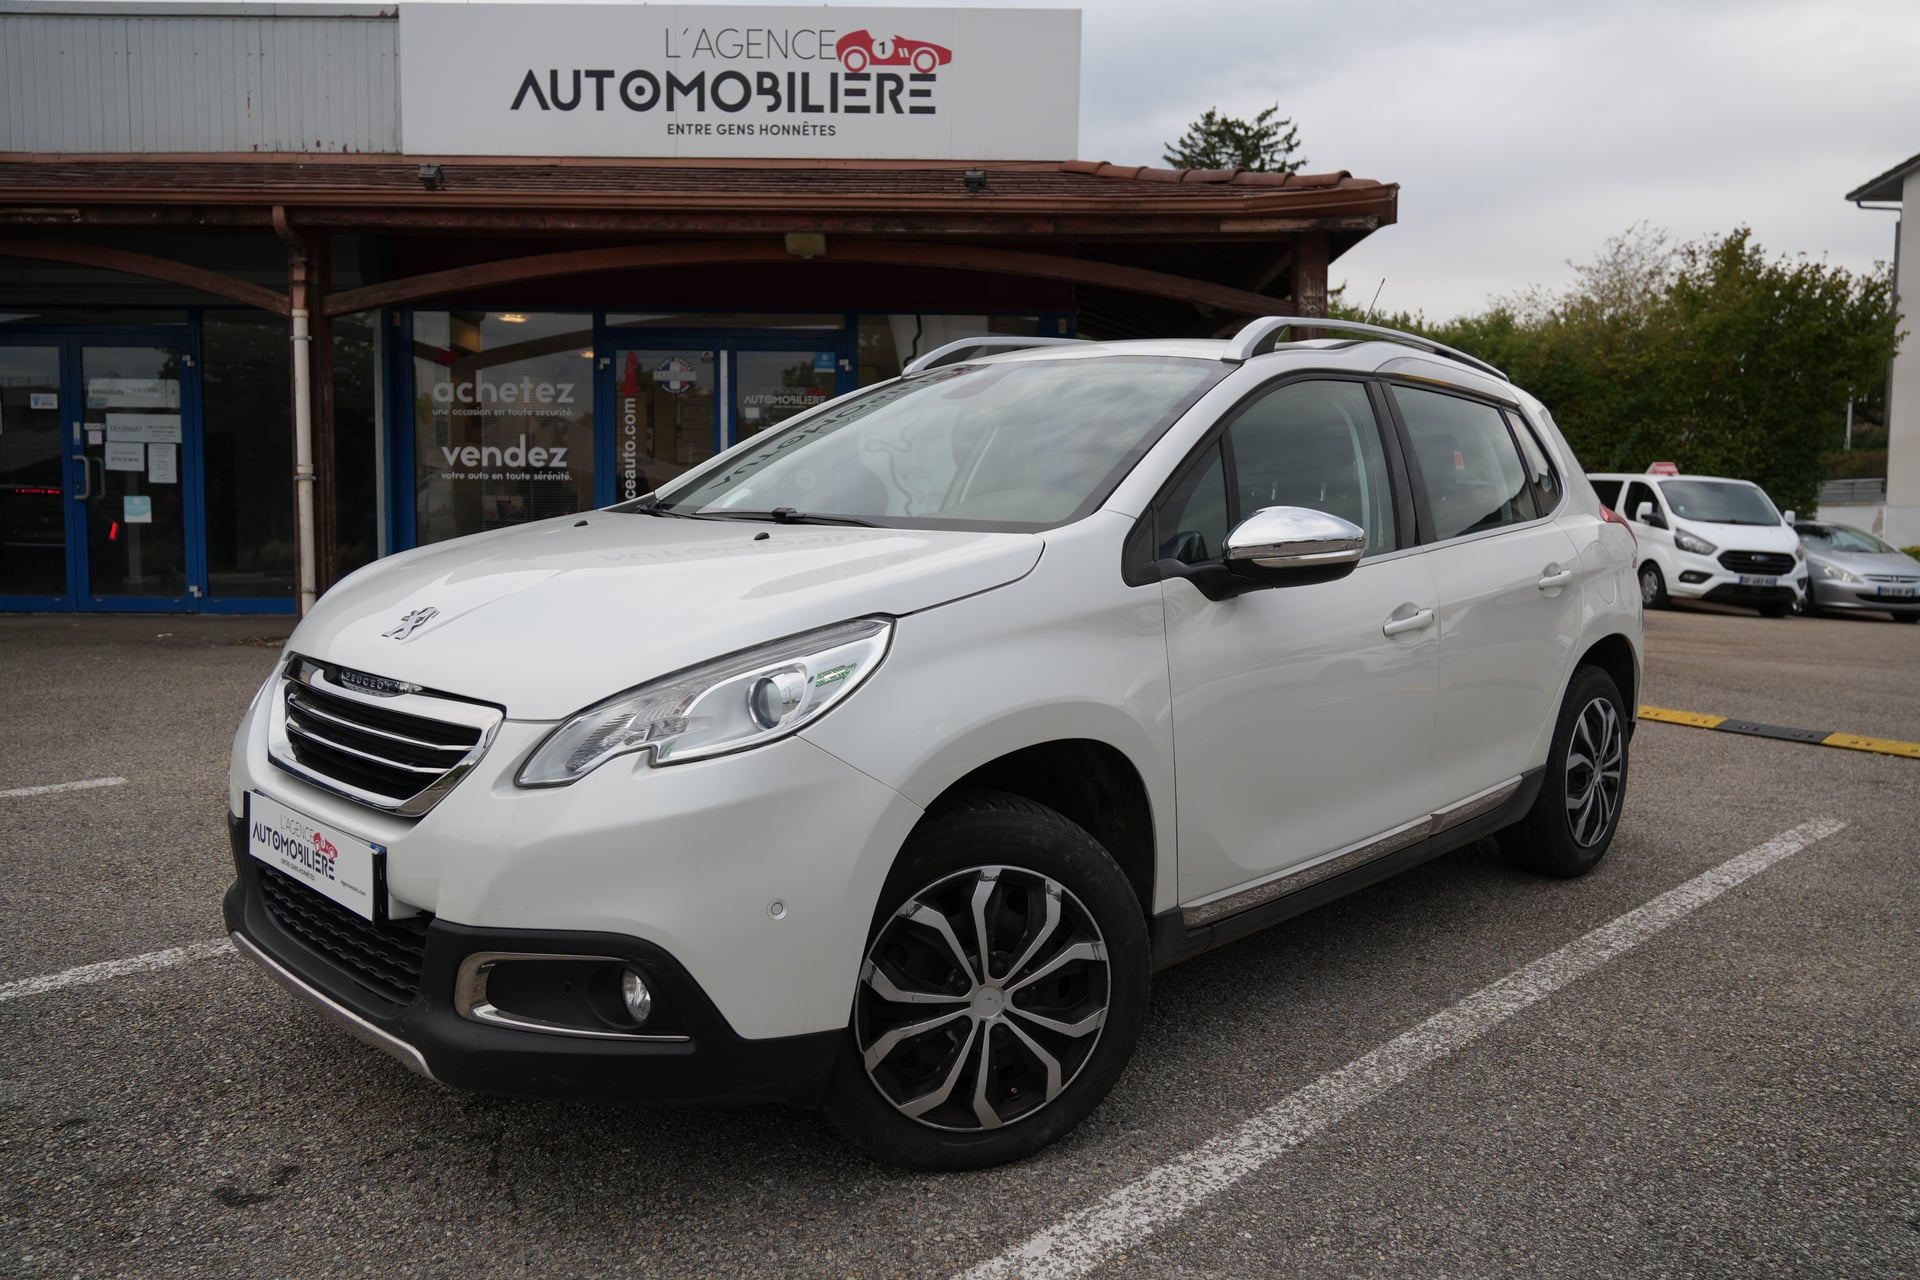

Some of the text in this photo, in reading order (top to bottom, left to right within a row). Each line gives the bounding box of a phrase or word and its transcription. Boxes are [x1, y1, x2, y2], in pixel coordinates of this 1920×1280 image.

[665, 27, 836, 60] L'AGENCE
[878, 41, 887, 55] 1
[509, 68, 936, 114] AUTOMOBILIERE
[667, 121, 836, 136] ENTRE GENS HONNÊTES
[432, 369, 575, 403] achetez
[432, 408, 449, 416] une
[452, 407, 492, 417] occasion
[508, 408, 533, 417] toute
[536, 408, 575, 417] sécurité.
[441, 434, 568, 468] vendez
[441, 472, 465, 480] votre
[467, 472, 489, 480] auto
[506, 471, 531, 480] toute
[533, 470, 573, 480] sérénité.
[345, 671, 393, 692] PEUGEOT
